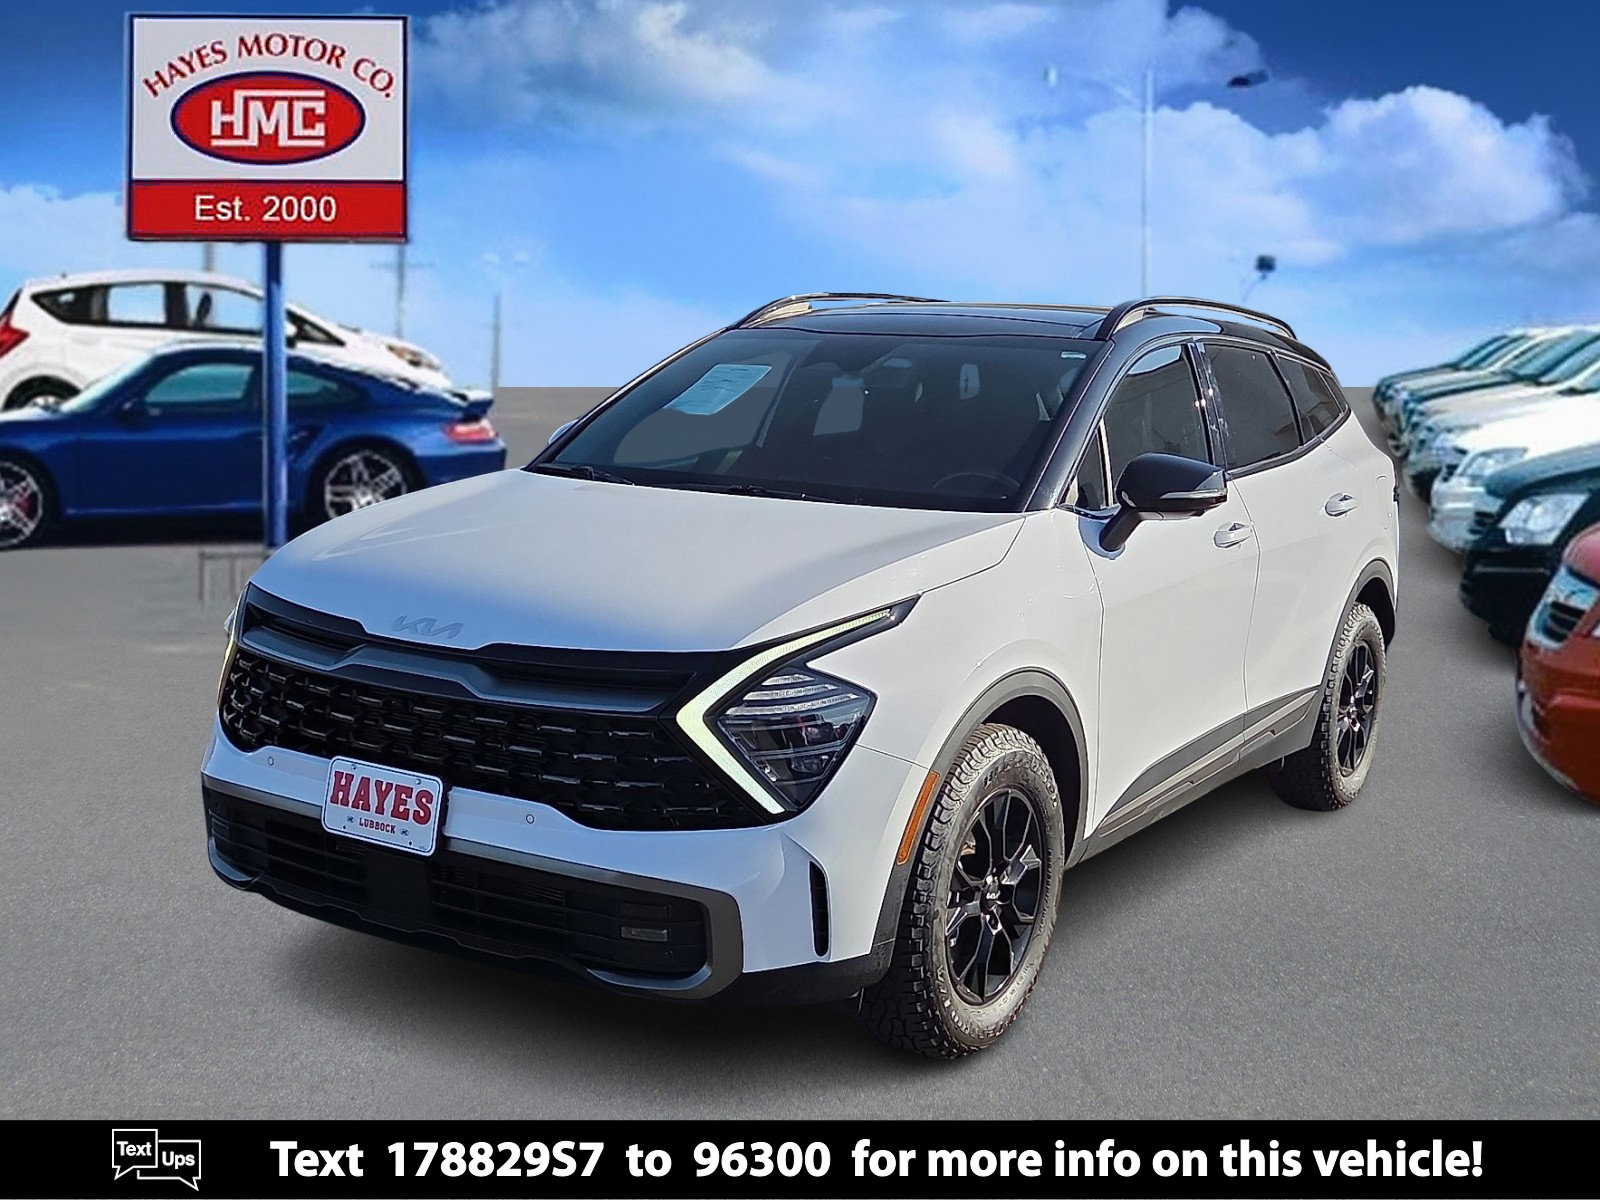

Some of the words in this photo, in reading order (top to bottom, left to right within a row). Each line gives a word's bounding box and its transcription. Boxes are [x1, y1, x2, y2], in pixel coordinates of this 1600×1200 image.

[143, 40, 228, 98] HAYES
[237, 33, 347, 70] MOTOR
[352, 57, 395, 99] CO.
[210, 89, 326, 148] HMC
[194, 195, 250, 222] Est.
[262, 195, 337, 222] 2000
[330, 770, 434, 825] HAYES
[358, 817, 397, 835] LUBBOCK
